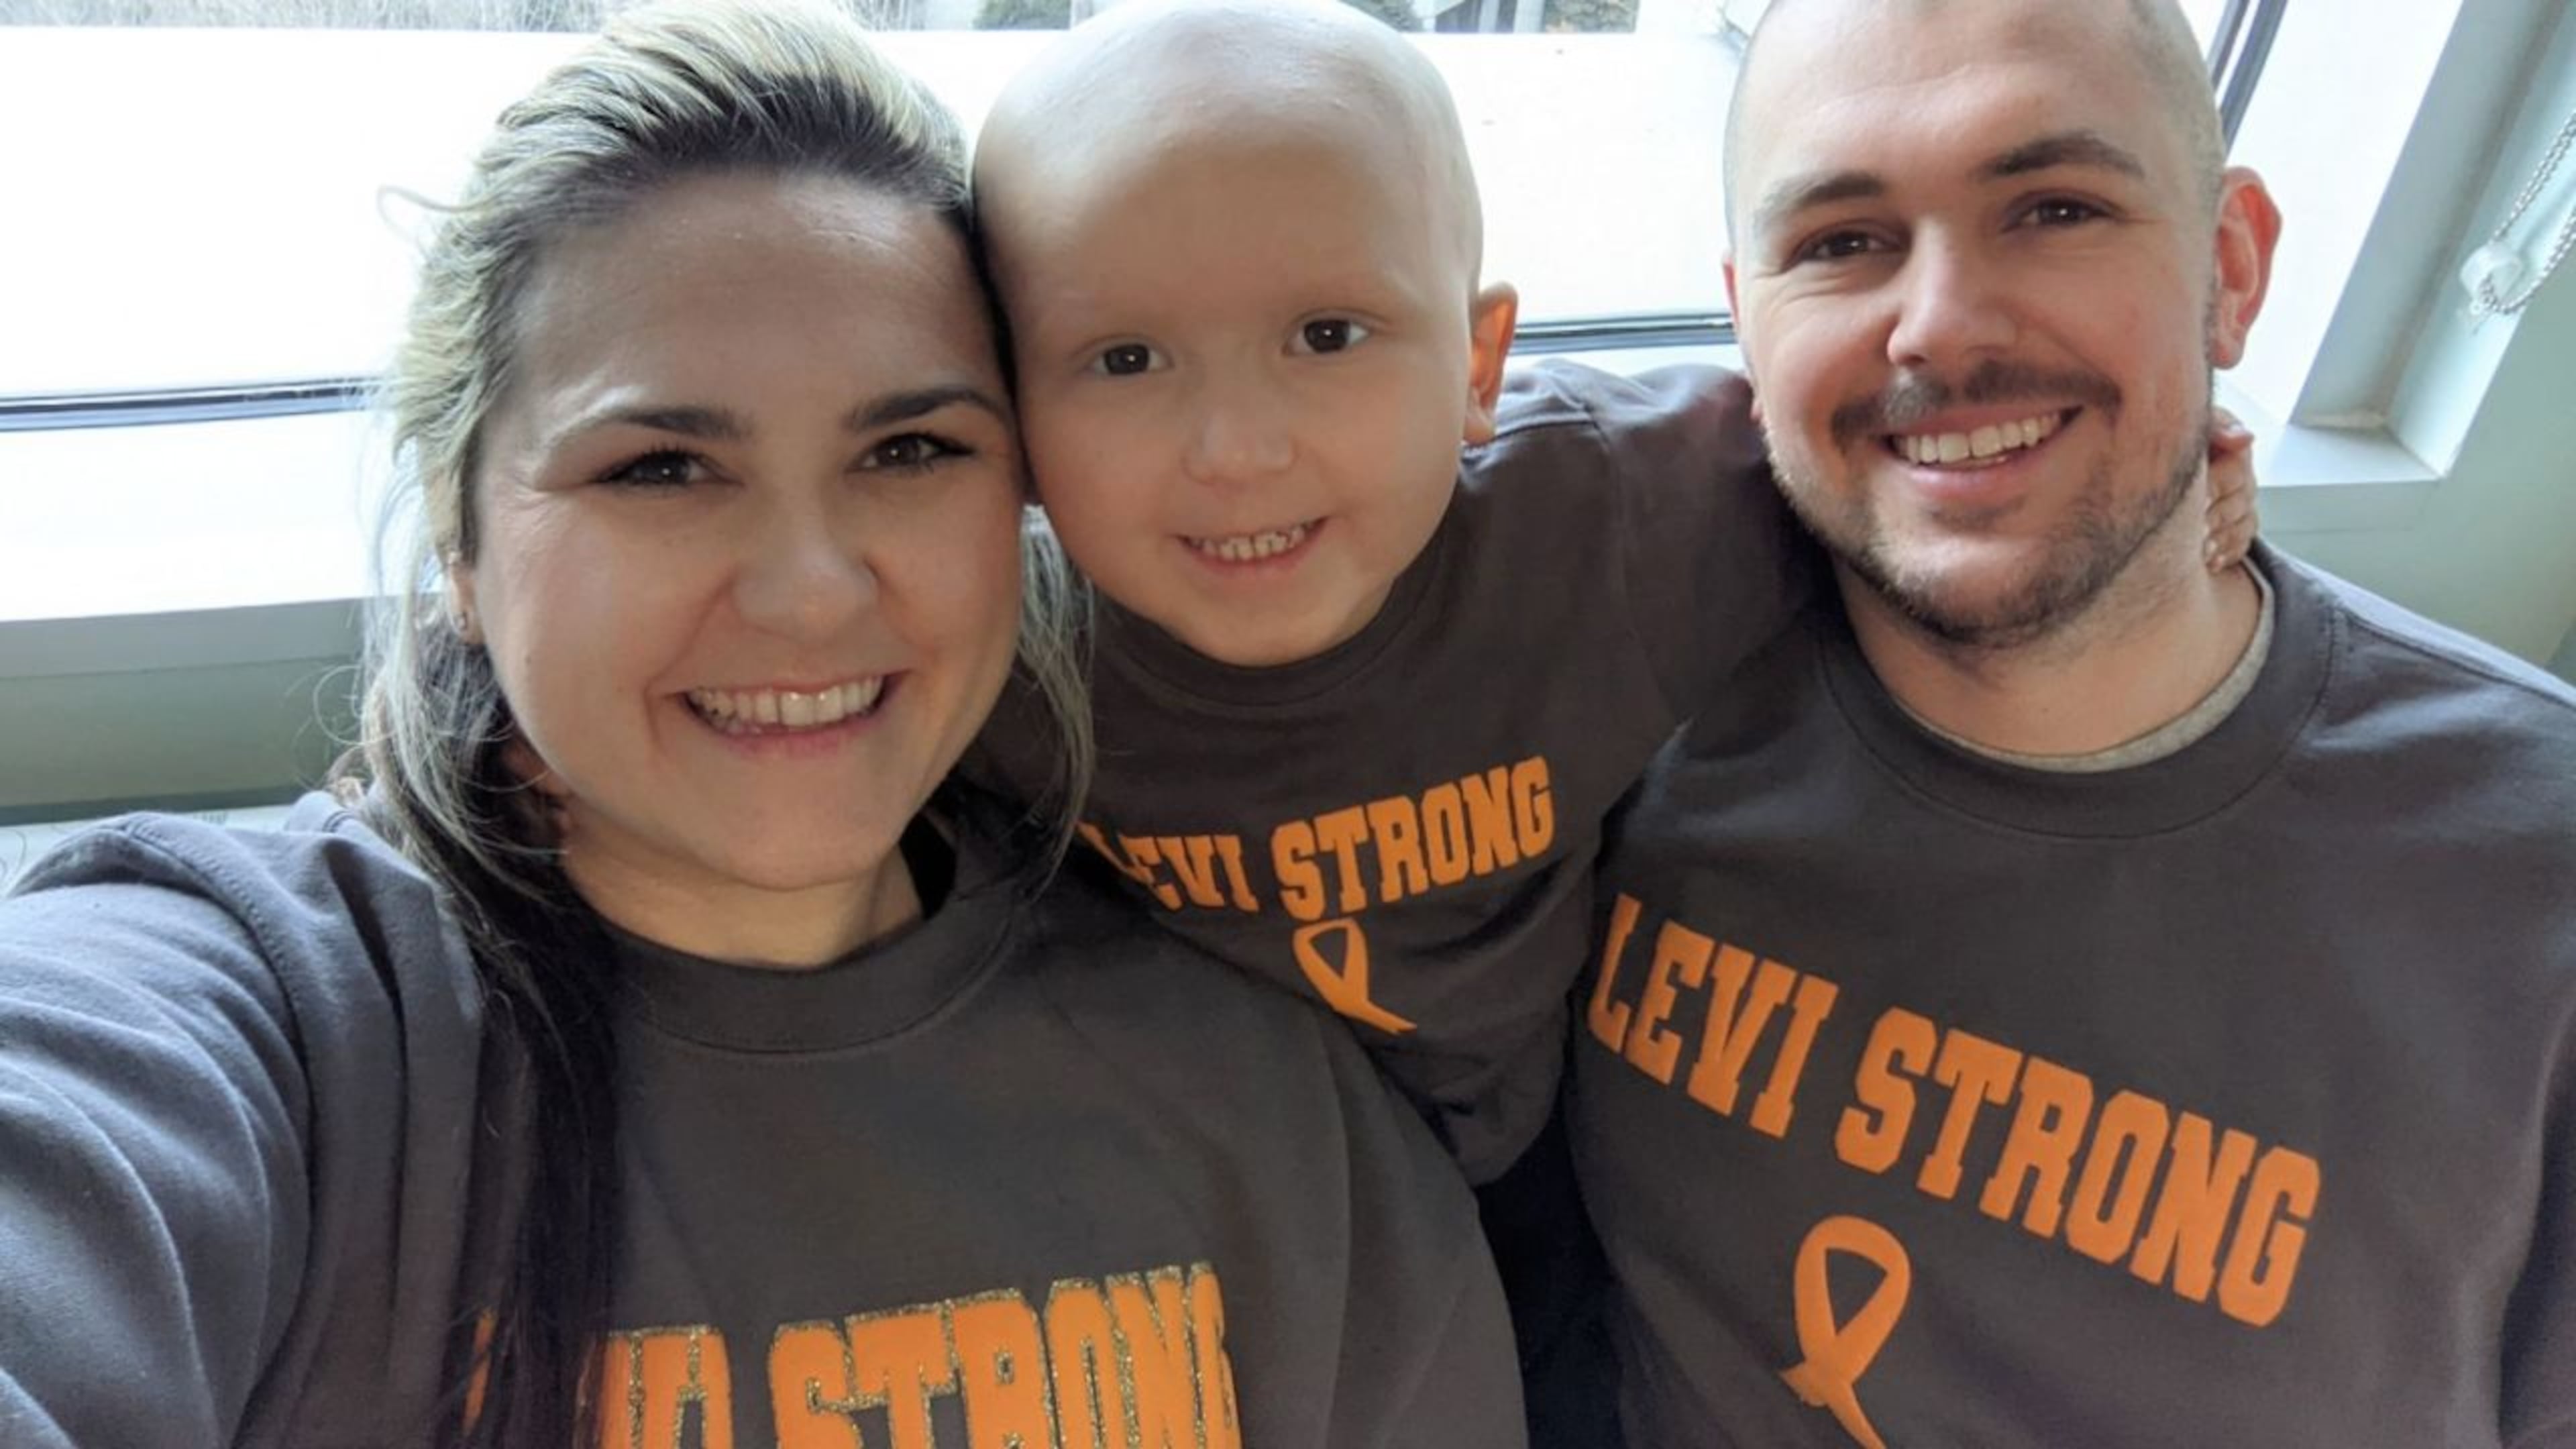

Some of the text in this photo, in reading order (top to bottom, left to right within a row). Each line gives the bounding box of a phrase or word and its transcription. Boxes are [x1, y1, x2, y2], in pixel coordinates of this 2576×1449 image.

[1271, 755, 1555, 922] STRONG
[1587, 893, 2320, 1328] LEVI STRONG
